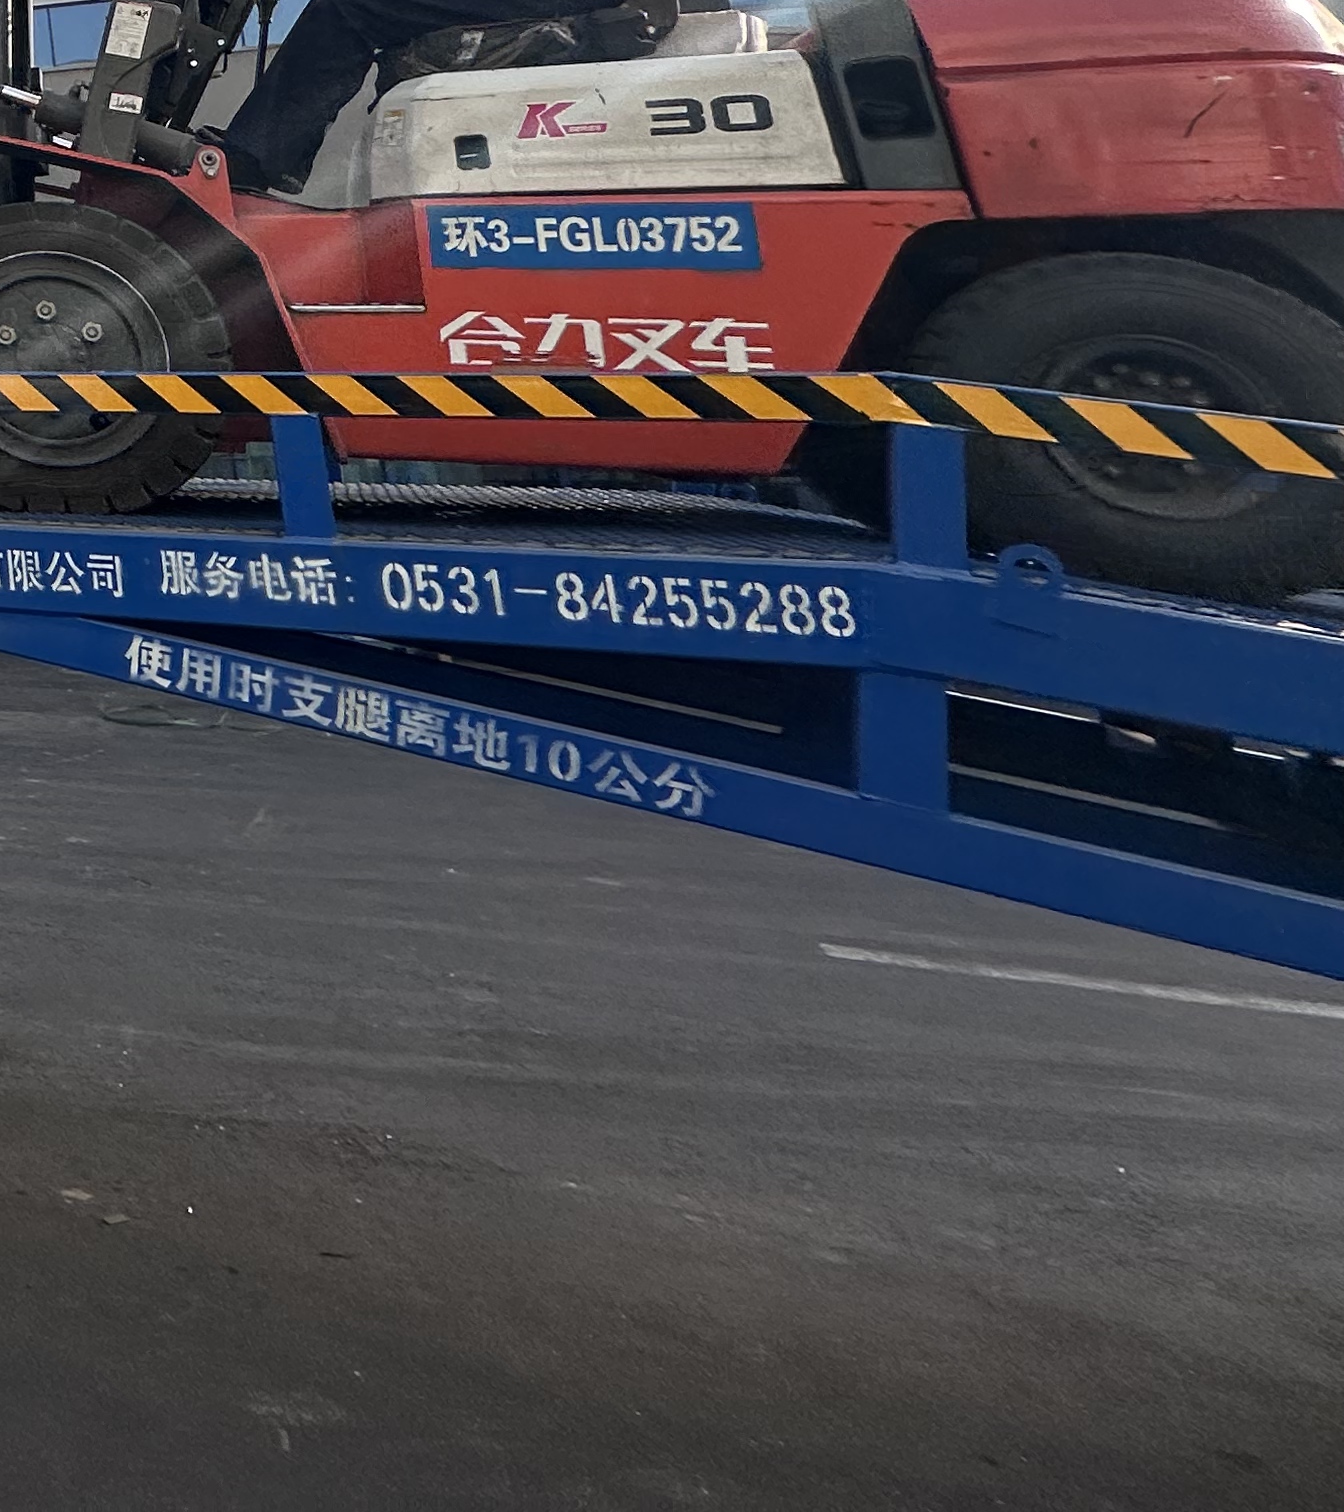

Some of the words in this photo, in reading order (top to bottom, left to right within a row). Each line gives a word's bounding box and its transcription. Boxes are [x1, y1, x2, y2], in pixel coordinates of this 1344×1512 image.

[516, 100, 576, 139] K
[645, 94, 774, 136] 30
[441, 216, 743, 257] 环3-FGL03752
[439, 311, 775, 373] 合力叉车
[380, 561, 858, 639] 0531-84255288
[123, 633, 716, 818] 使用时支腿离地10公分
